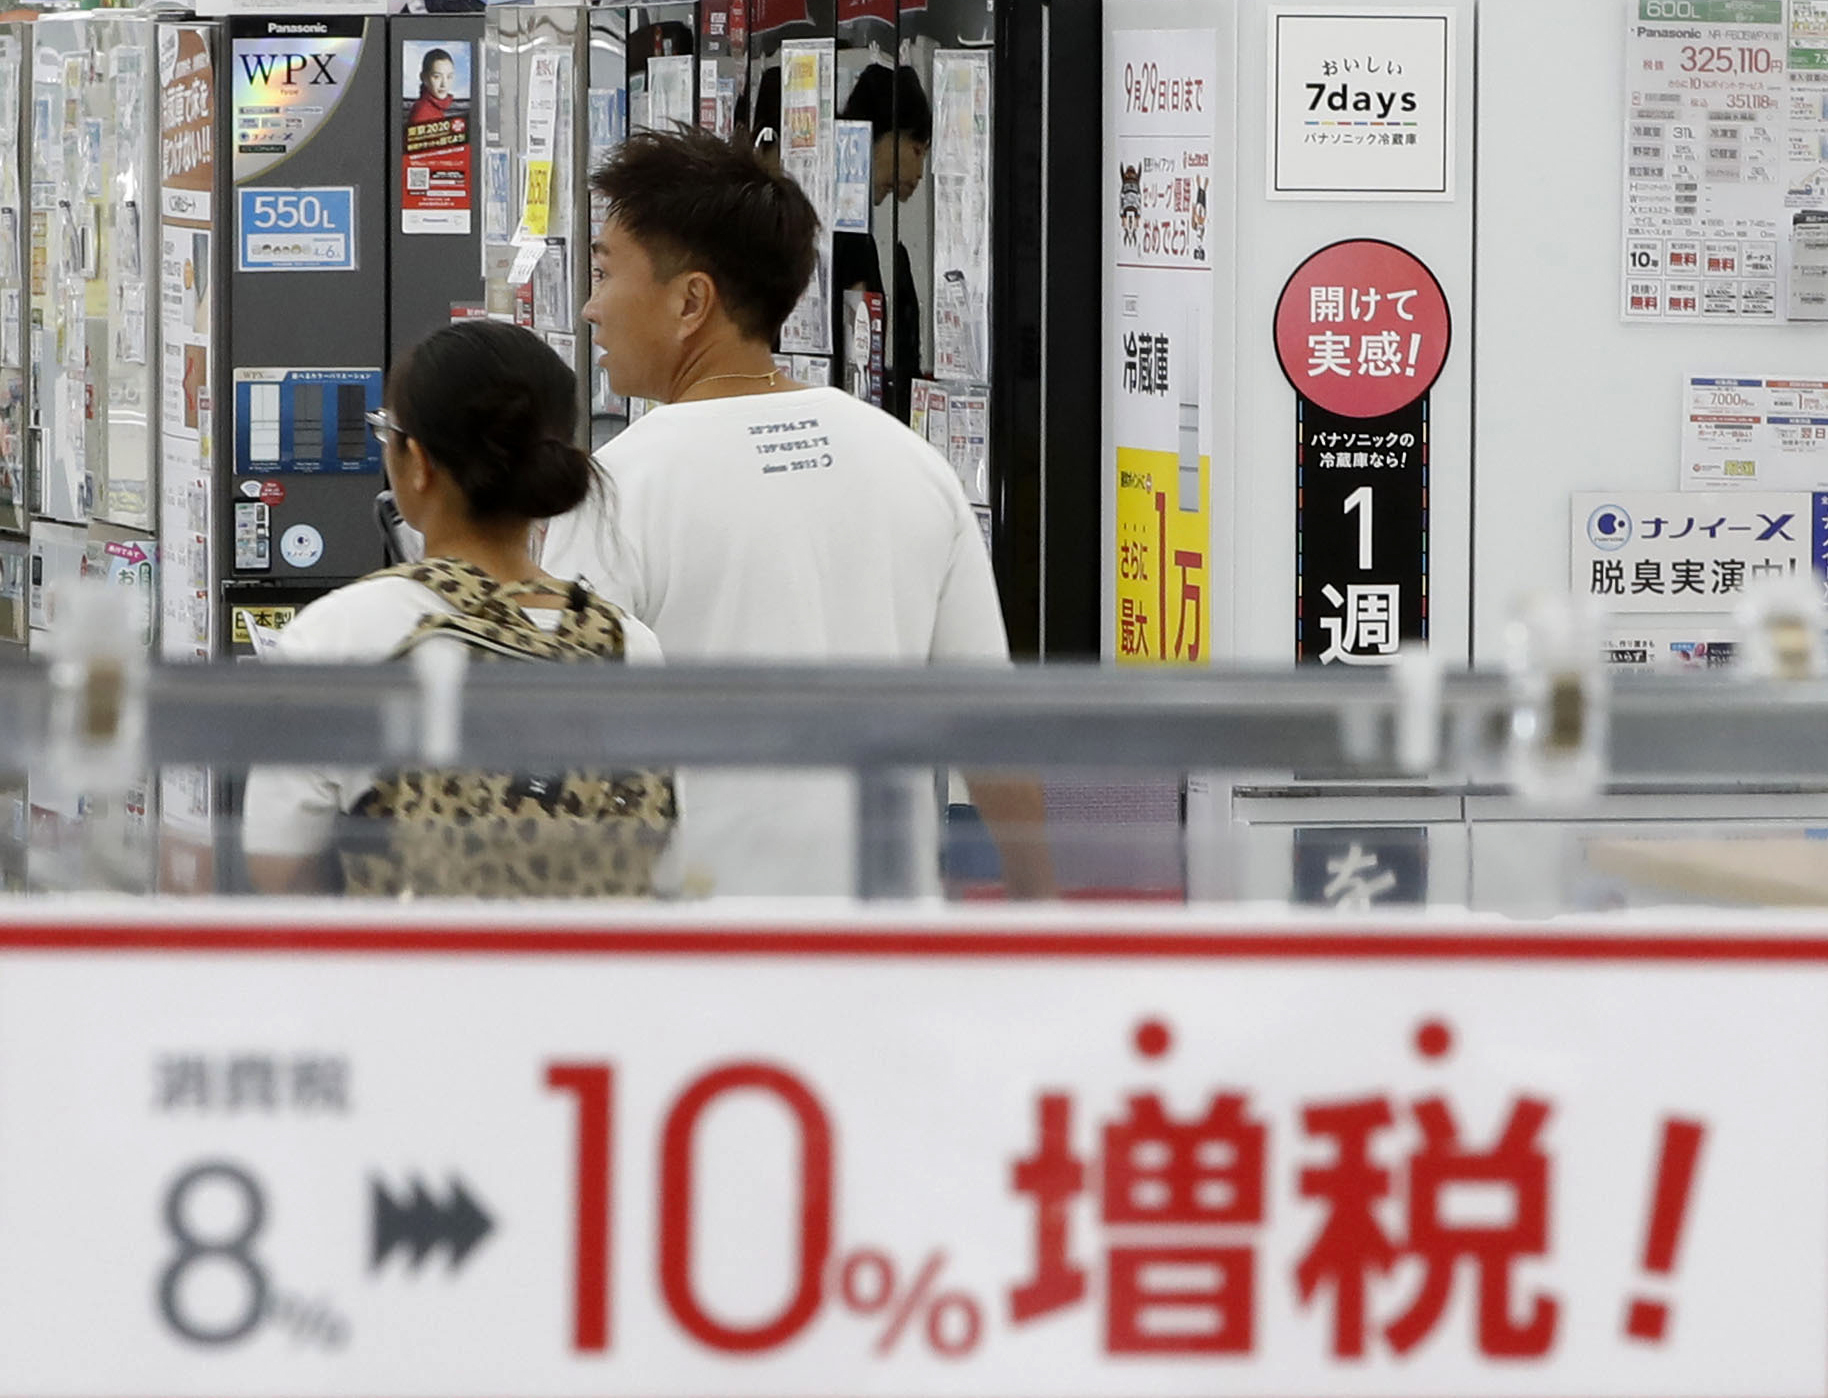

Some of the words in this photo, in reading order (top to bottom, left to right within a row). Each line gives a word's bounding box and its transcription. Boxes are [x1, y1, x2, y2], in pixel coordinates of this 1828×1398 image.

[267, 22, 328, 34] Panasonic
[1637, 26, 1702, 39] Panasonic
[239, 53, 338, 86] WPX
[1321, 56, 1403, 76] おいしい
[1680, 46, 1783, 76] 325,110円
[1124, 62, 1204, 114] 9月29日(日)まで
[1305, 83, 1418, 118] 7days
[1304, 132, 1418, 146] パナソニック冷蔵庫
[254, 195, 336, 229] 550L
[1143, 219, 1190, 256] おめでとう!
[1669, 252, 1697, 267] 無料
[1707, 258, 1735, 272] 無料
[1310, 285, 1419, 323] 開けて
[1630, 296, 1658, 310] 無料
[1668, 298, 1696, 311] 無料
[1123, 331, 1169, 397] 冷蔵庫
[1307, 330, 1422, 379] 実感!
[1312, 431, 1415, 449] パナソニックの
[1319, 451, 1408, 469] 冷蔵庫なら!
[1641, 513, 1796, 541] ナノイーX
[1120, 539, 1149, 582] さらに
[1121, 599, 1151, 657] 最大
[543, 1058, 985, 1360] 10%
[1010, 1088, 1707, 1361] 増税!
